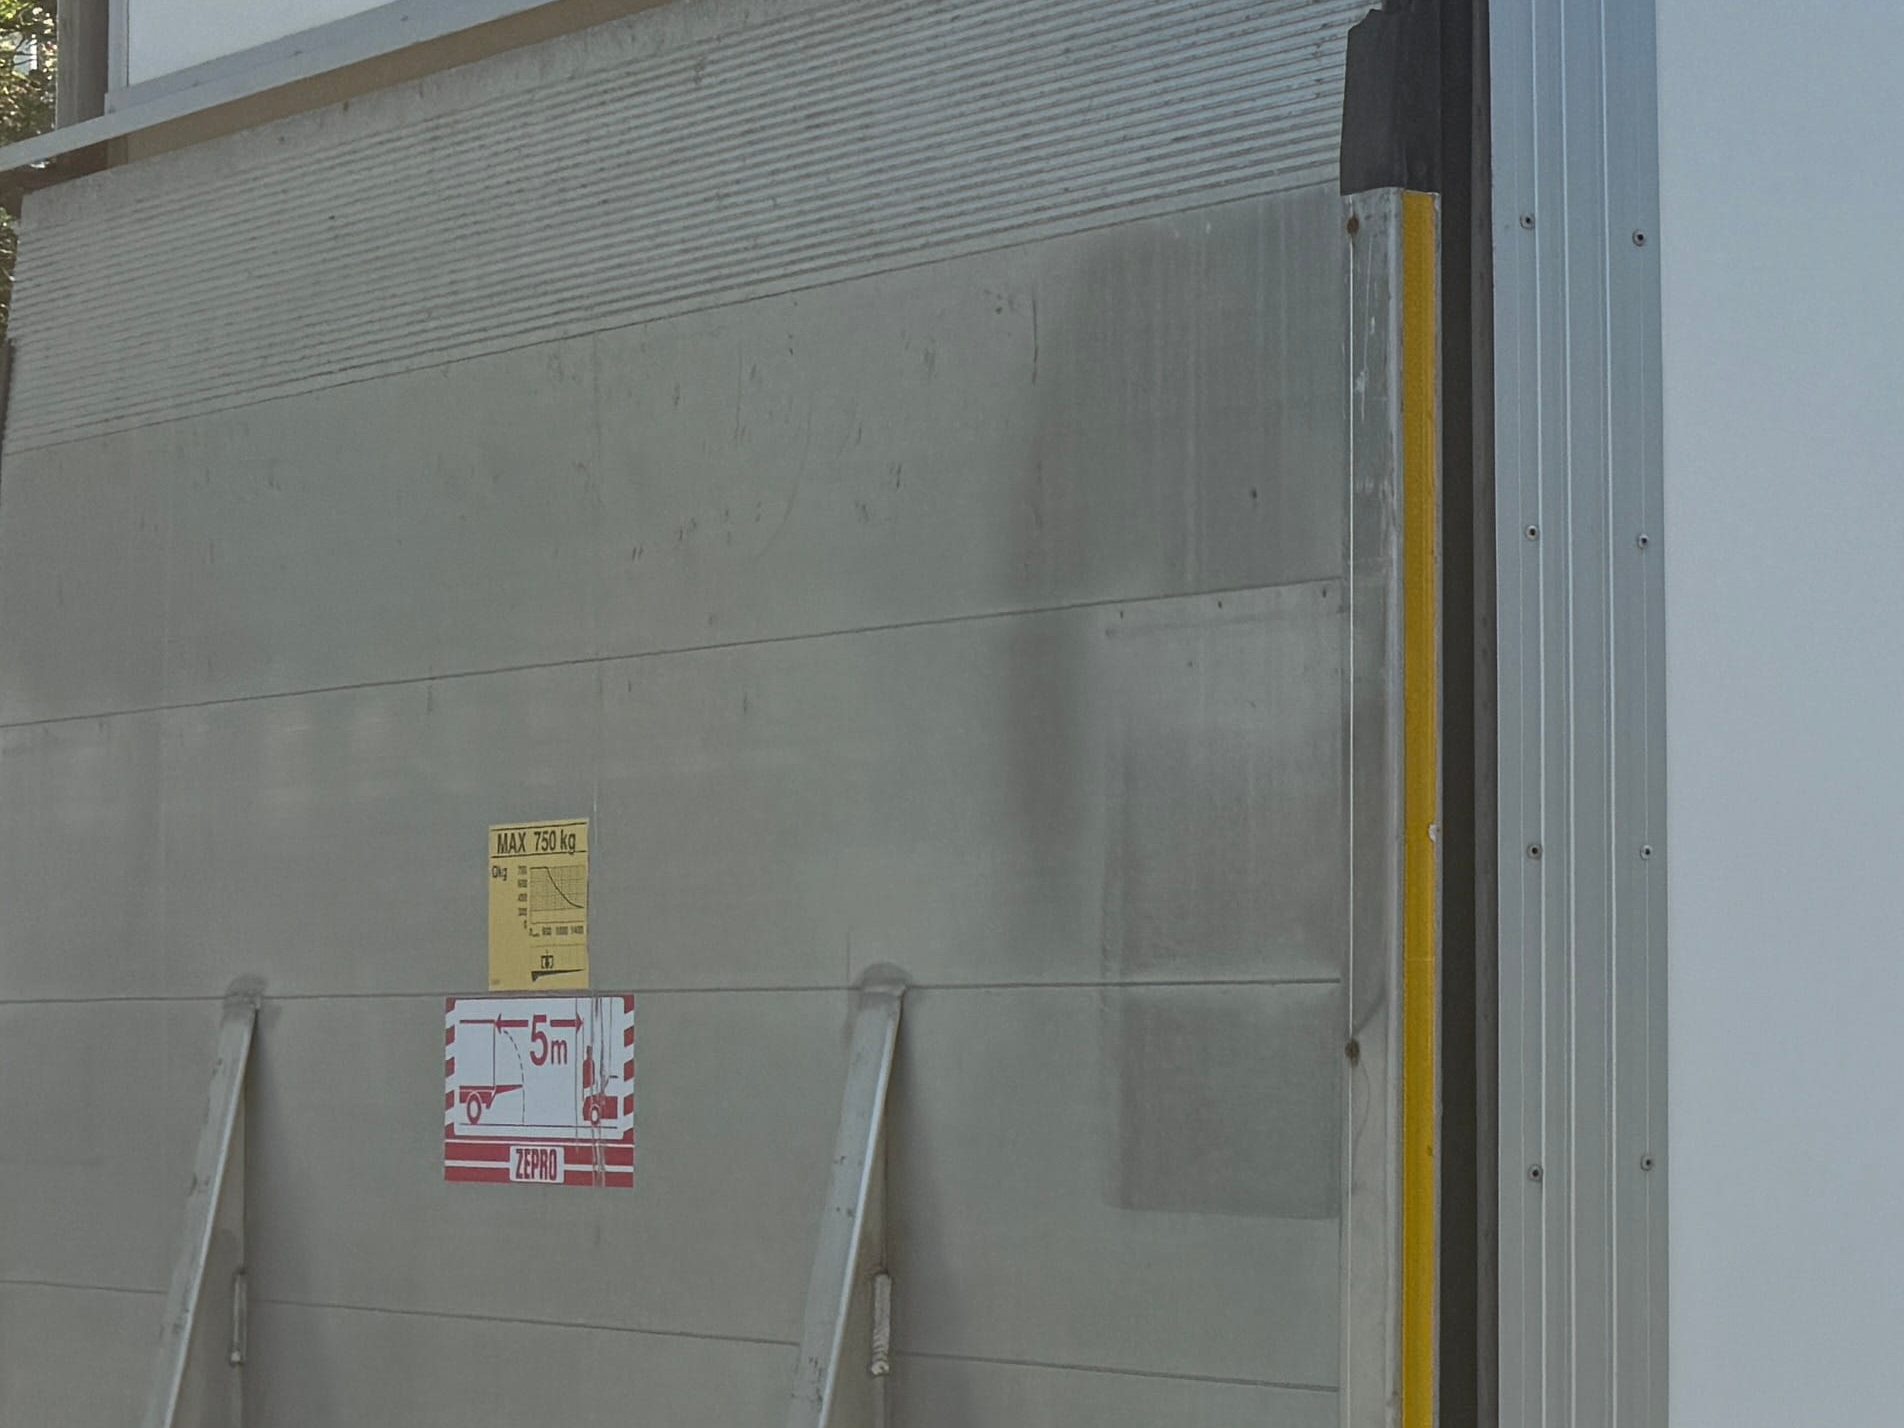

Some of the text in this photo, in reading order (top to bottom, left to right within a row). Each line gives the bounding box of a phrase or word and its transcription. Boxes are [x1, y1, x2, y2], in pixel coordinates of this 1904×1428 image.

[496, 829, 576, 854] MAX 750 kg
[515, 1147, 558, 1182] ZEPRO
